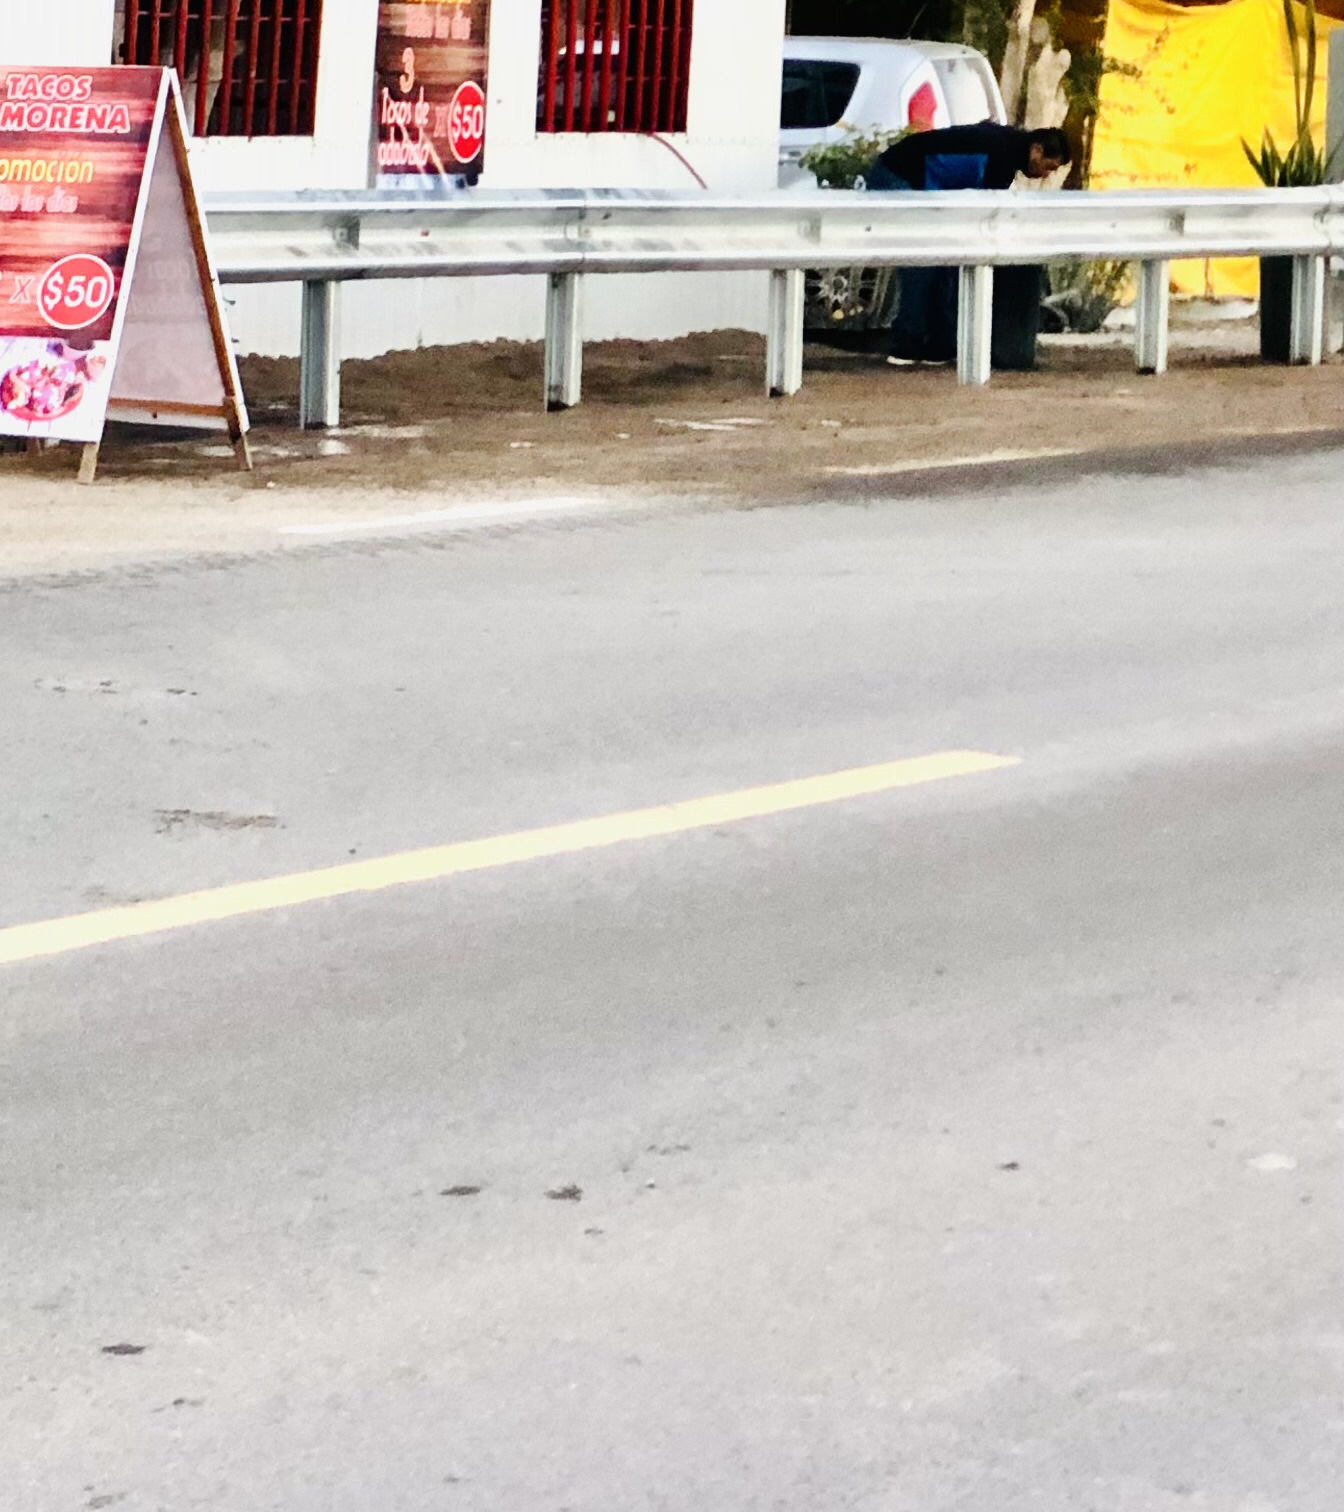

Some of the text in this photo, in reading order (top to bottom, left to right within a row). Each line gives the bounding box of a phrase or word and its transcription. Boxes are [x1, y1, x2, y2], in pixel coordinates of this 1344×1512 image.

[6, 74, 93, 101] TACOS
[400, 47, 415, 93] 3
[381, 85, 430, 124] Tacos de
[452, 101, 484, 143] $50
[44, 271, 108, 310] $50
